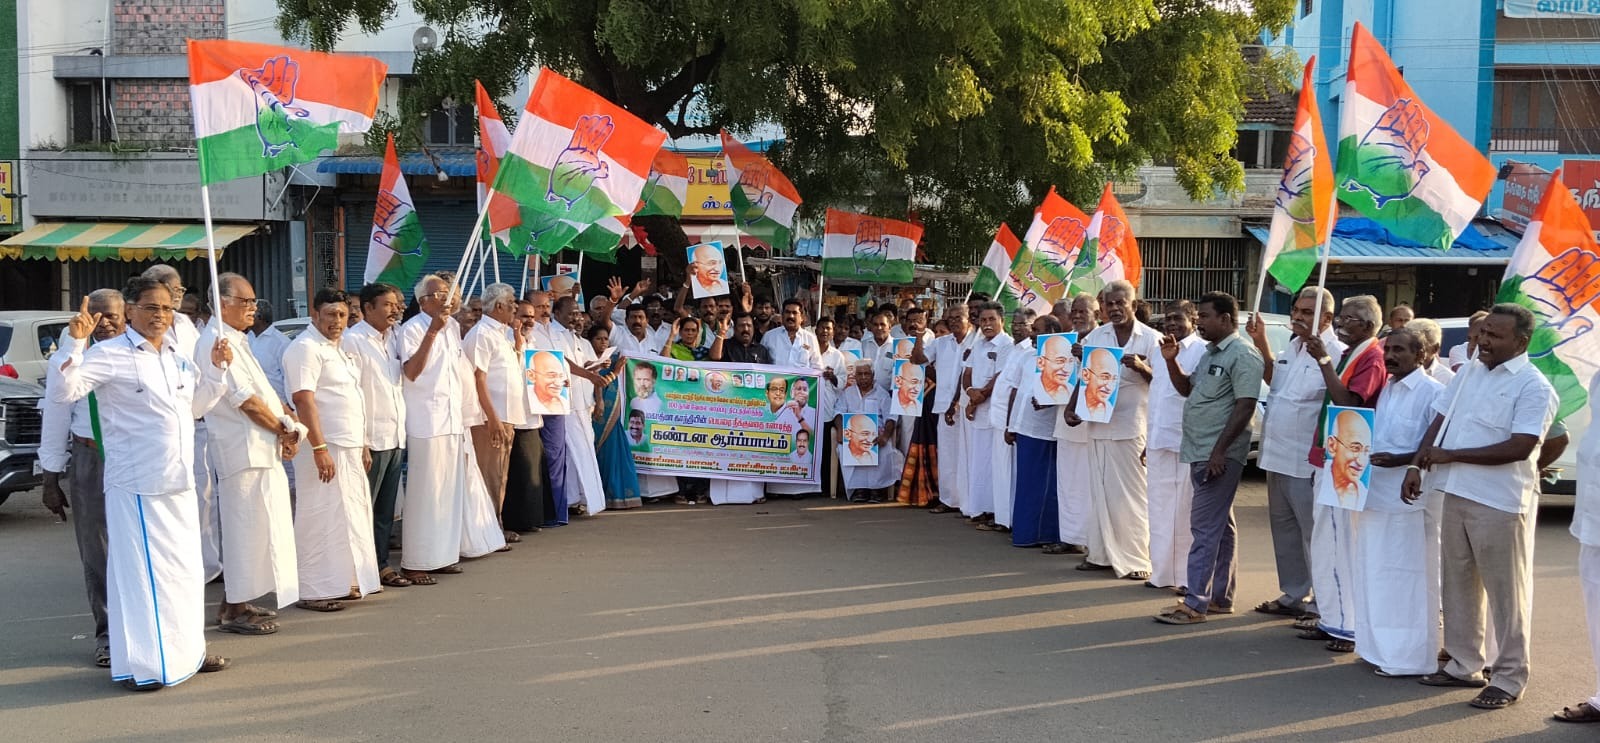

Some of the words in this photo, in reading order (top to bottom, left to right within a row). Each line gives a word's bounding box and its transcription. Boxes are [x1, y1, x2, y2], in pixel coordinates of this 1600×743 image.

[674, 413, 707, 425] காந்தியின்
[653, 427, 708, 444] கண்டன
[711, 431, 789, 449] ஆர்ப்பாட்டம்
[727, 462, 778, 475] காங்கிரஸ்
